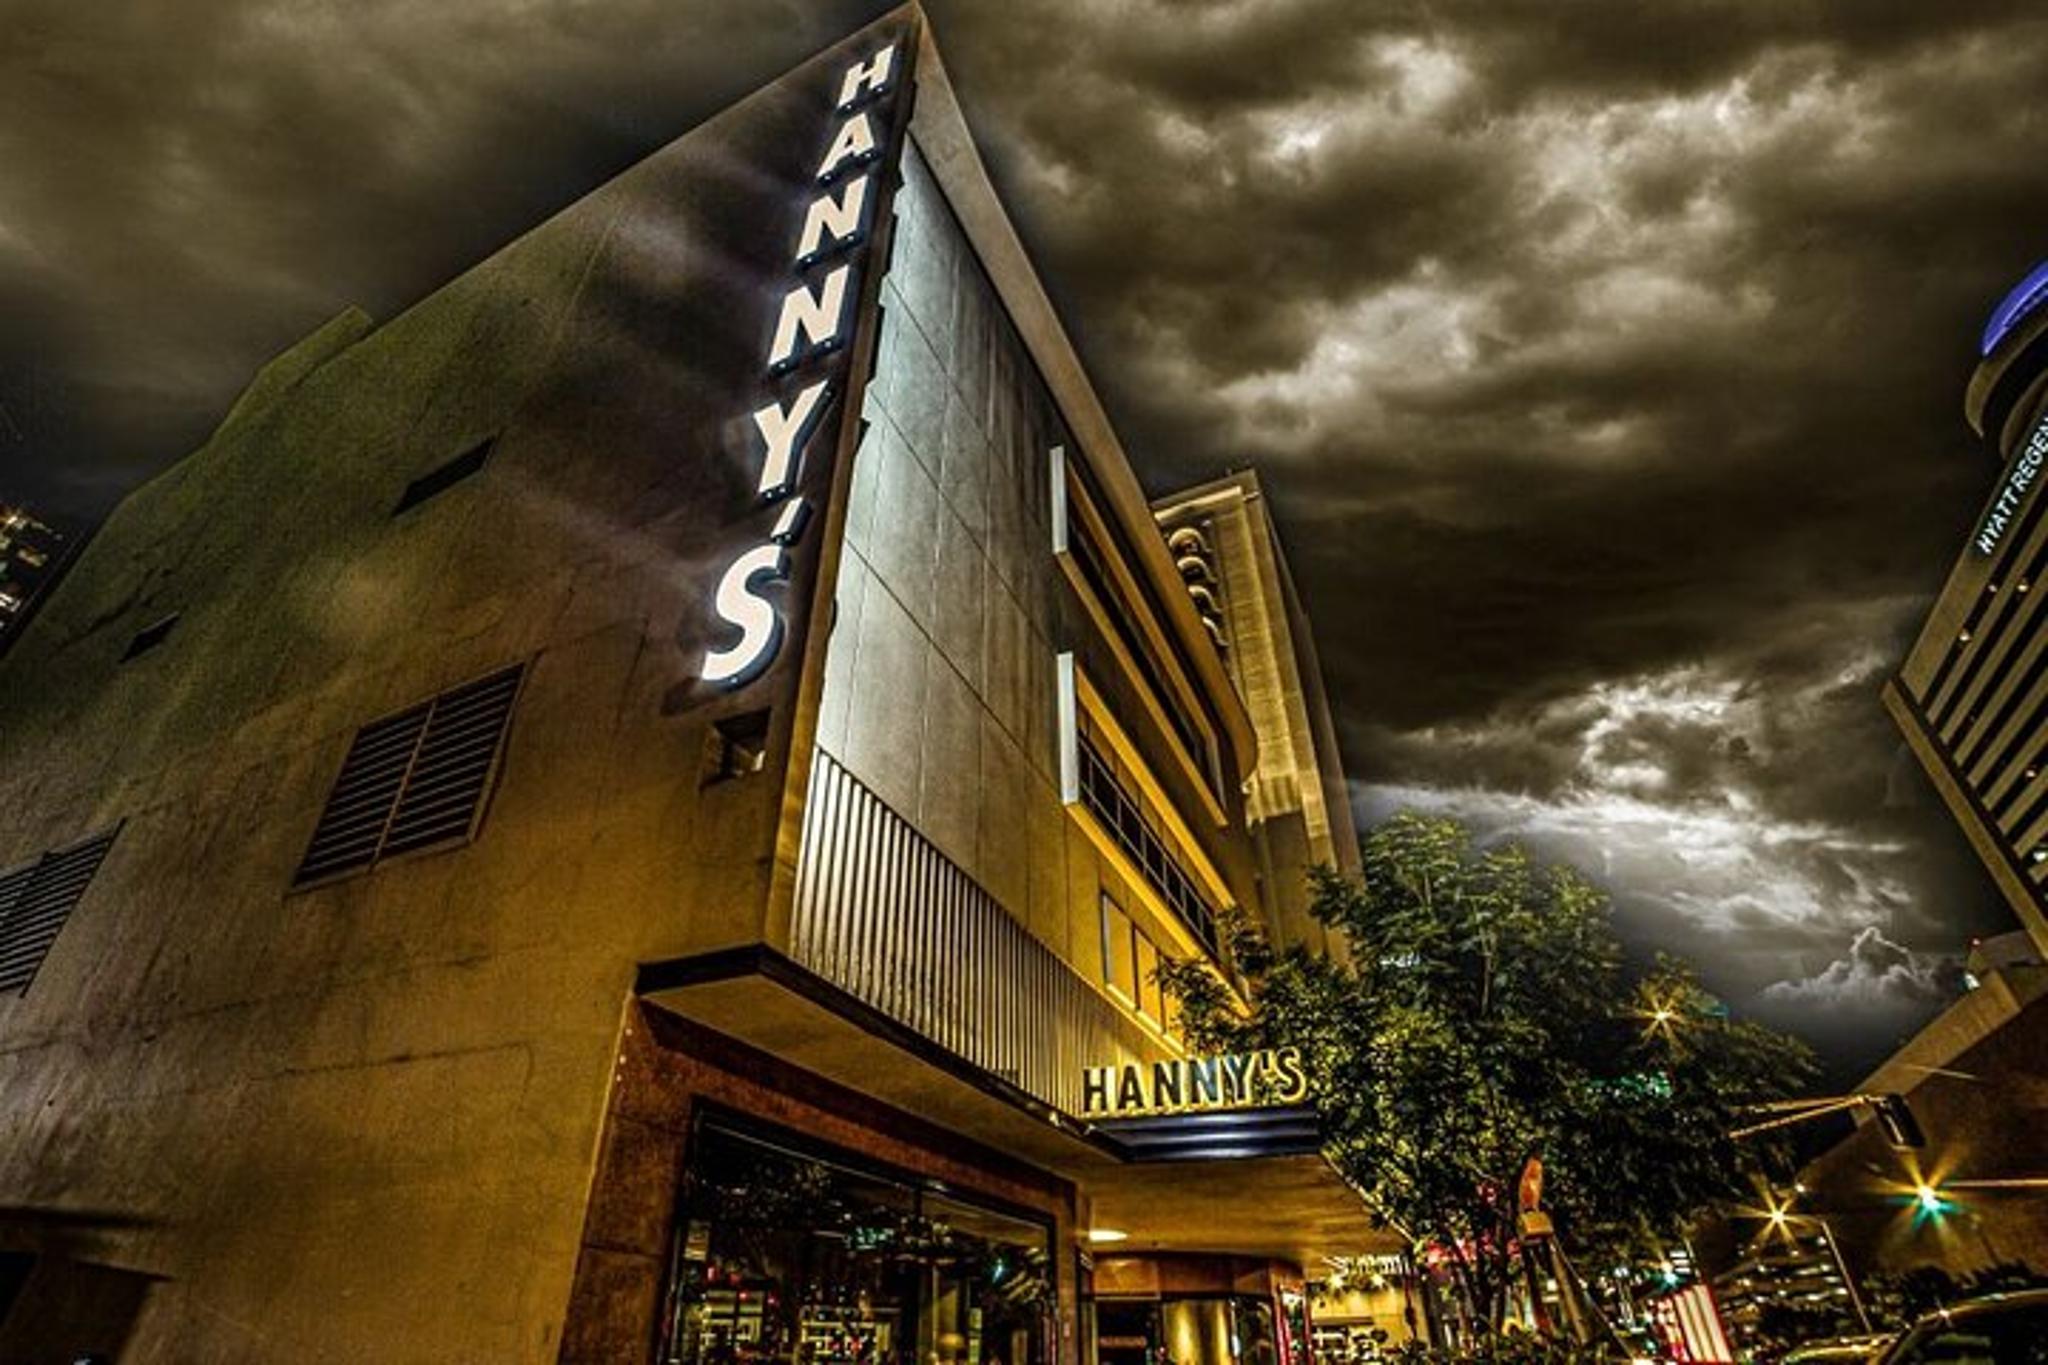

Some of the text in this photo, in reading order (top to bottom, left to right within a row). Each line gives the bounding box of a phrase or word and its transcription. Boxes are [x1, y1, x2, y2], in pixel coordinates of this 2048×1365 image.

[702, 45, 895, 688] HANNY'S
[1976, 486, 2018, 554] HYATT
[1083, 1047, 1306, 1112] HANNY'S
